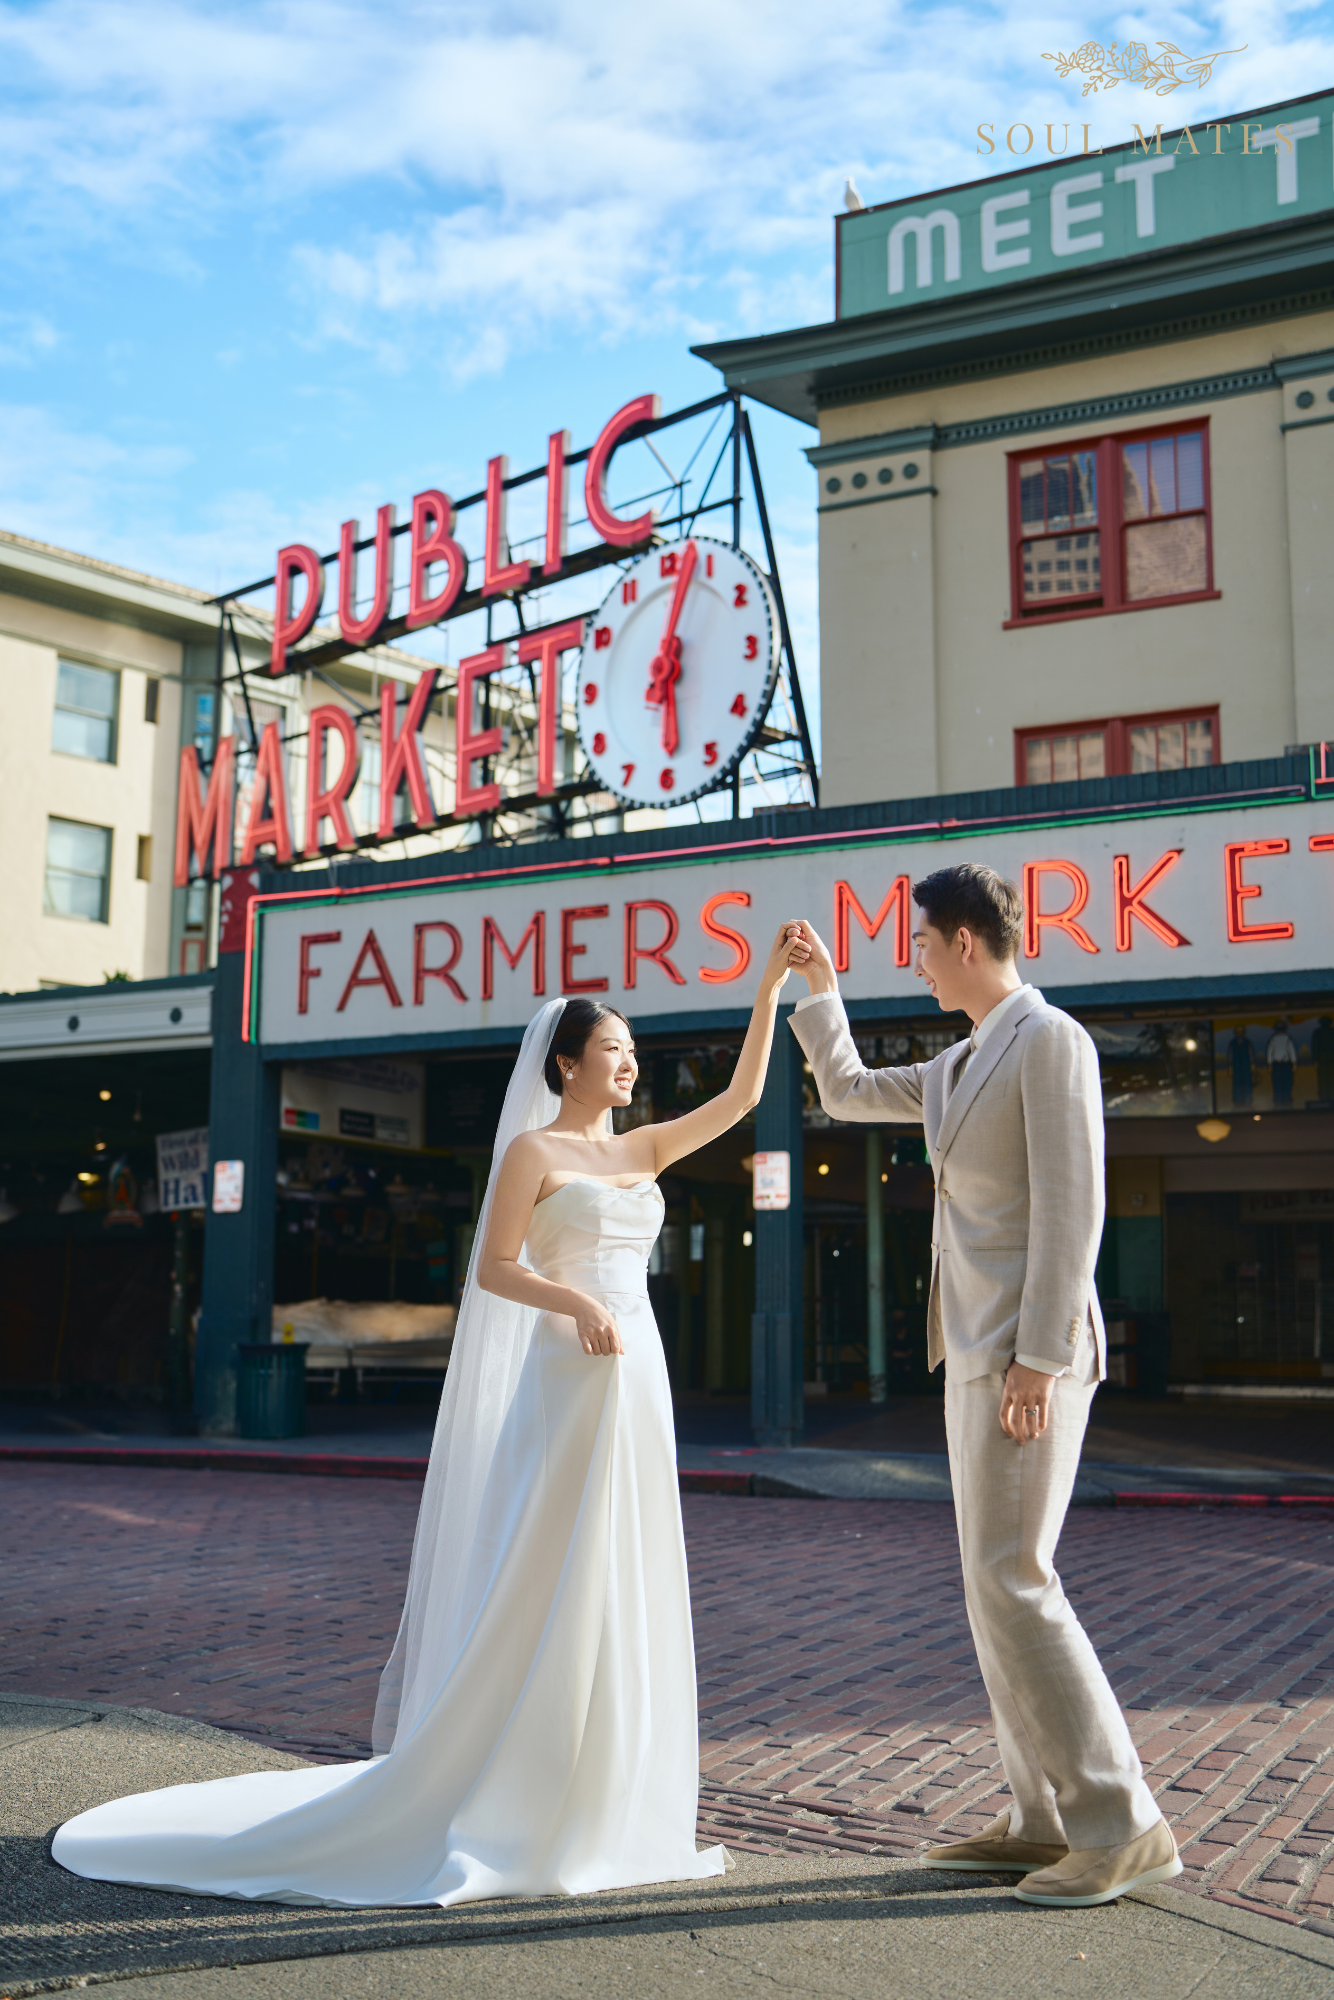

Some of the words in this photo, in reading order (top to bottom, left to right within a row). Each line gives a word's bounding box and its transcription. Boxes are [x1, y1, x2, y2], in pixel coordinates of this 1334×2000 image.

[886, 155, 1176, 296] MEET
[269, 393, 662, 675] PUBLIC
[706, 553, 714, 578] 1
[622, 579, 638, 605] 11
[734, 583, 748, 608] 2
[744, 635, 758, 660] 3
[584, 683, 598, 705] 9
[729, 693, 748, 718] 4
[174, 618, 586, 888] MARKET
[592, 732, 607, 756] 8
[703, 741, 718, 766] 5
[621, 763, 636, 787] 7
[659, 768, 675, 791] 6
[297, 891, 751, 1015] FARMERS
[833, 832, 1334, 972] MRKE
